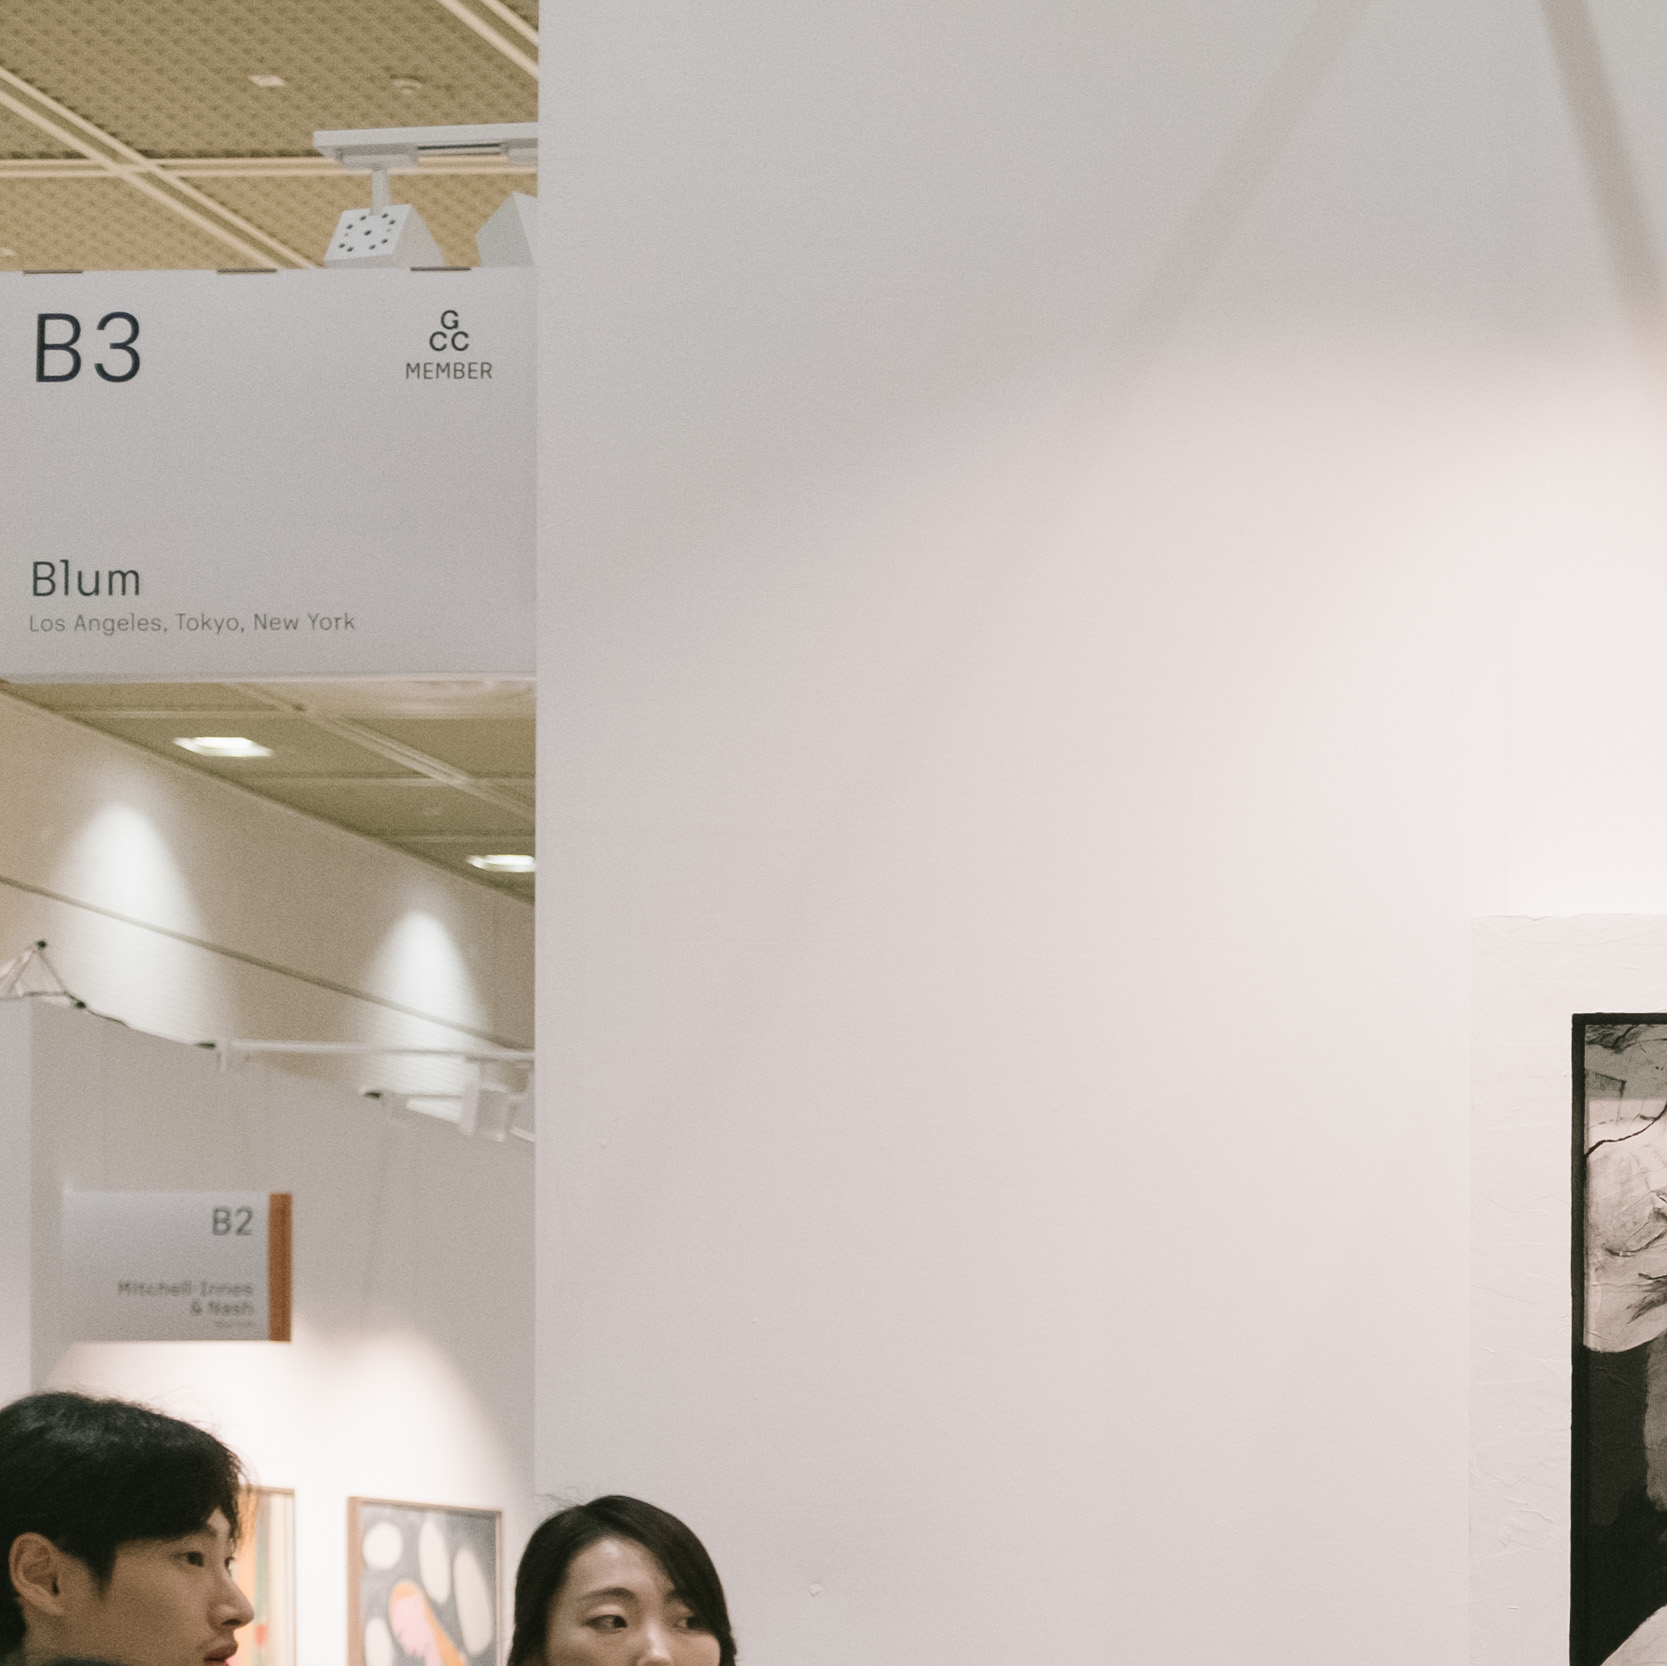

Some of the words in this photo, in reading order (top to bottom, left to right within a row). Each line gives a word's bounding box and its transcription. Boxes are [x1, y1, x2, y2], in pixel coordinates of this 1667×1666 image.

[37, 312, 140, 382] B3
[405, 361, 493, 380] MEMBER
[32, 558, 140, 597] Blum
[29, 615, 66, 633] Los
[74, 612, 168, 637] Angeles,
[176, 612, 245, 635] Tokyo,
[253, 613, 299, 631] New
[308, 612, 355, 631] York
[212, 1207, 253, 1236] B2
